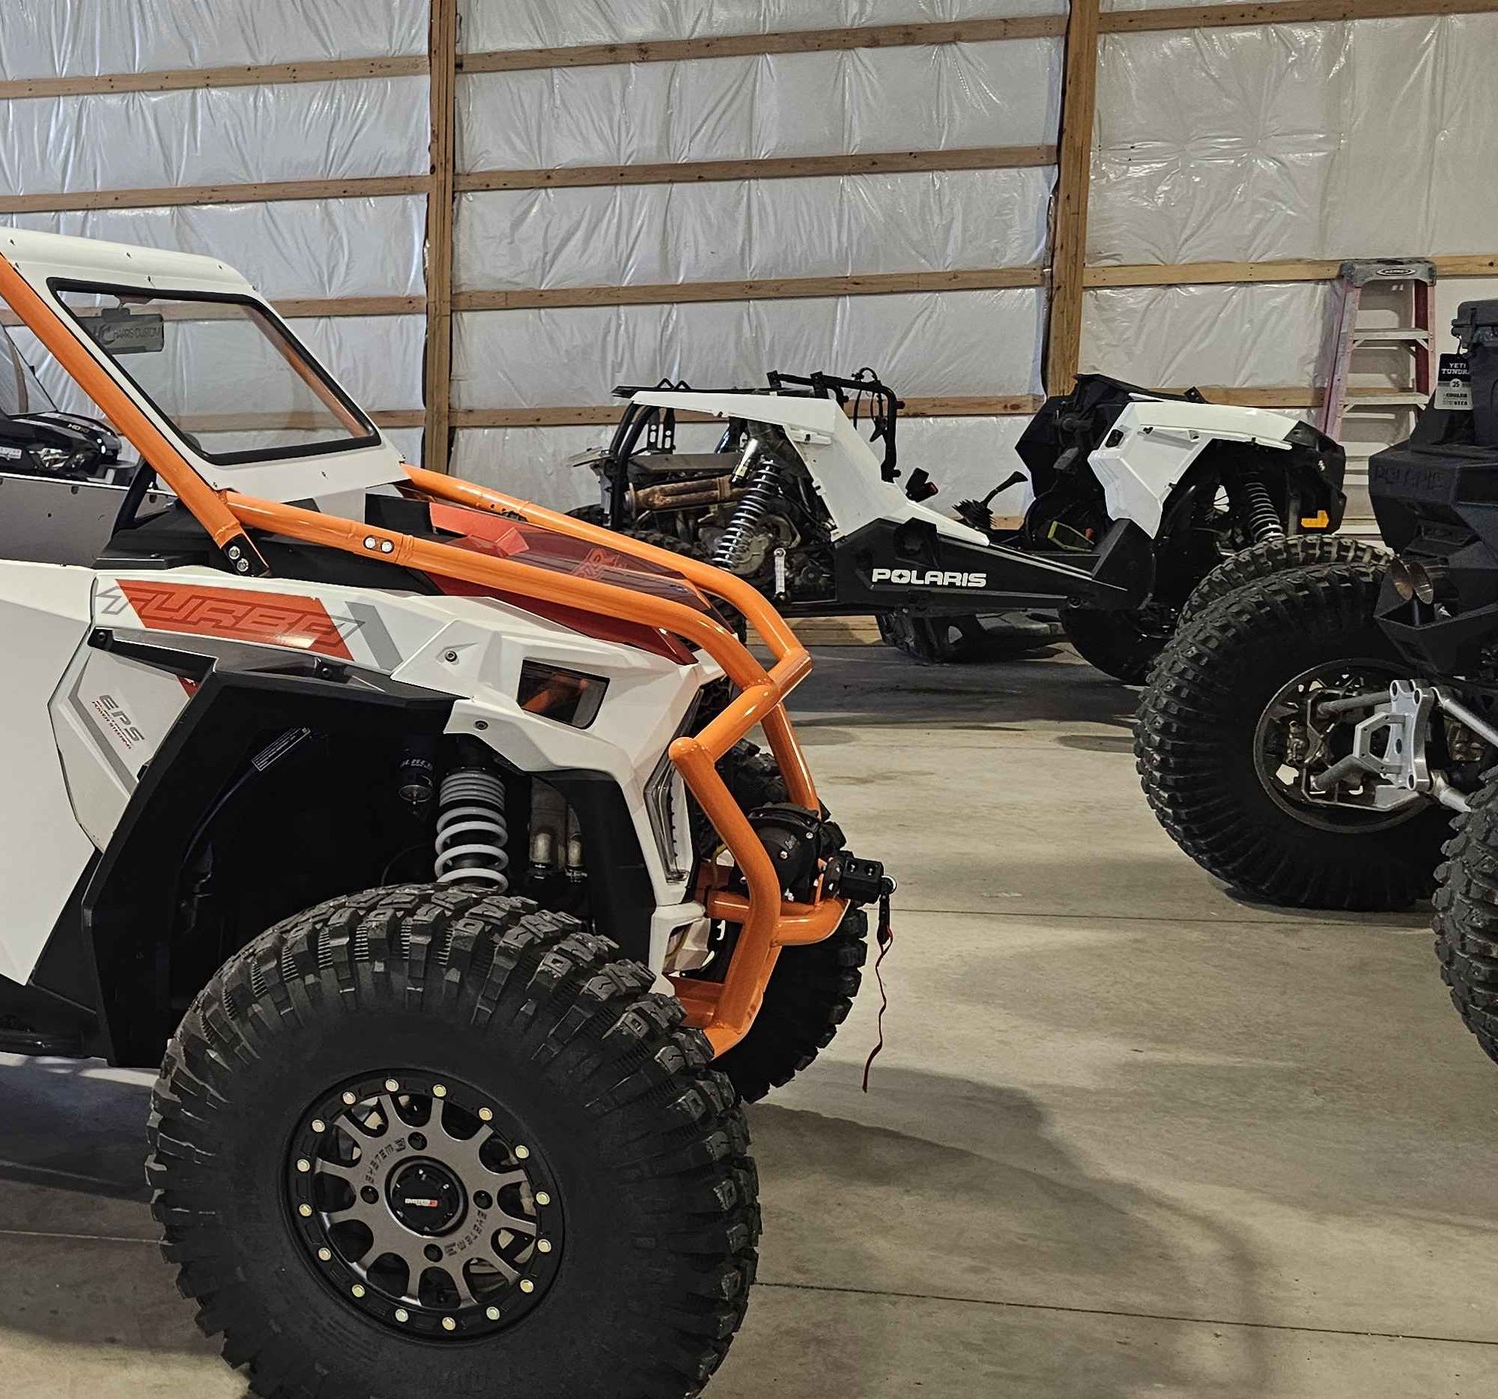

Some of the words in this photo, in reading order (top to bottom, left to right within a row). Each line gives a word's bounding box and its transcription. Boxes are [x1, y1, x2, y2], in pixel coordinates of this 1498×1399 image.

[871, 568, 988, 588] POLARIS
[95, 584, 366, 647] TURBO
[98, 694, 146, 742] EPS
